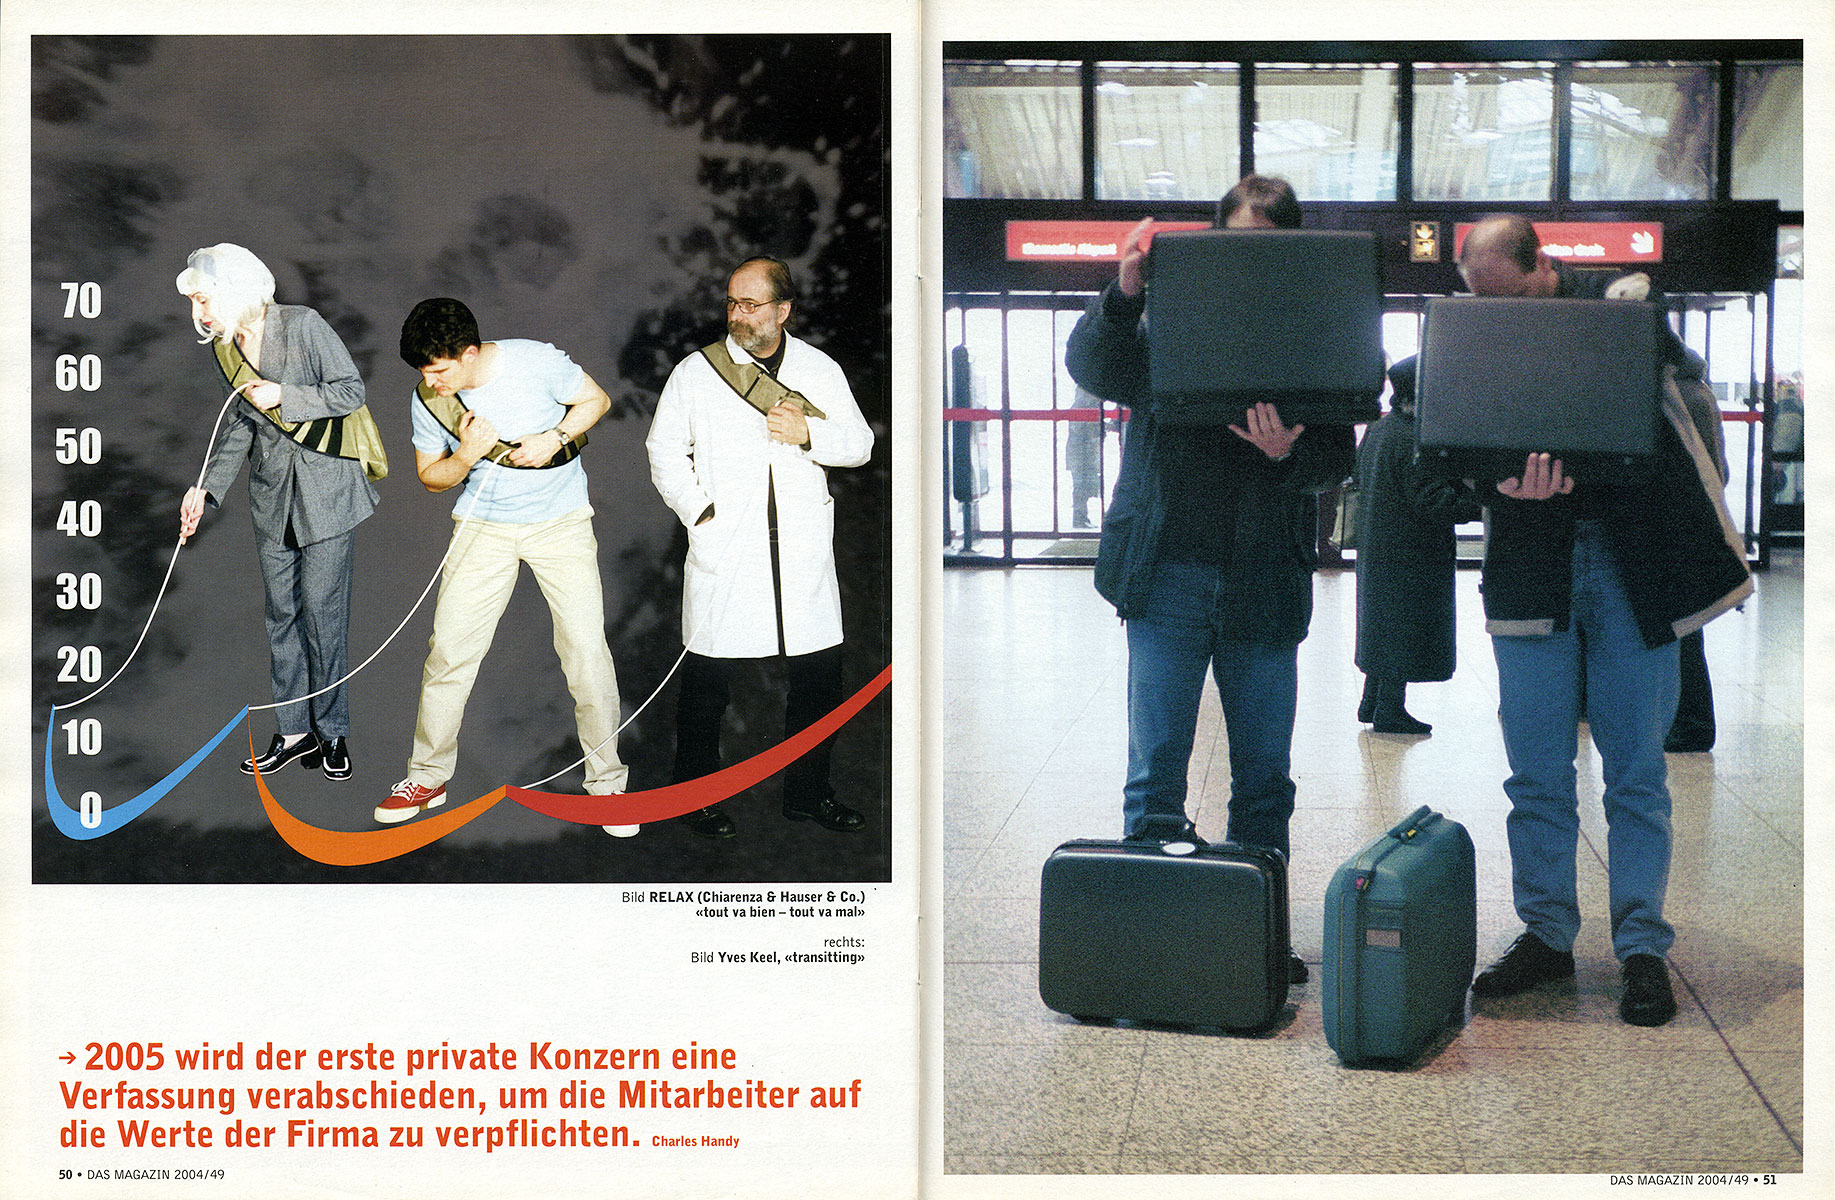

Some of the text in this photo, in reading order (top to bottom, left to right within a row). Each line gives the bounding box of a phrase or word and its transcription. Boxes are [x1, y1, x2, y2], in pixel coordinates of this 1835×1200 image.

[60, 281, 102, 319] 70
[55, 354, 102, 392] 60
[55, 427, 102, 465] 50
[56, 500, 102, 537] 40
[56, 572, 102, 610] 30
[56, 645, 102, 683] 20
[61, 718, 102, 756] 10
[79, 791, 102, 829] 0
[622, 891, 866, 905] Bild RELAX (Chiarenza & Hauser & Co.)
[695, 906, 729, 918] «tout
[732, 908, 747, 918] va
[750, 906, 776, 918] bien
[789, 906, 815, 918] tout
[818, 908, 832, 918] va
[835, 906, 865, 918] mal»
[691, 951, 865, 965] Bild Yves Keel, «transitting»
[824, 936, 866, 948] rechts:
[84, 1040, 737, 1077] 2005 wird der erste private Konzern eine
[58, 1078, 862, 1115] Verfassung verabschieden, um die Mitarbeiter auf
[60, 1118, 640, 1154] die Werte der Firma zu verpflichten.
[652, 1135, 740, 1149] Charles Handy
[58, 1169, 225, 1181] 50 DAS MAGAZIN 2004/49
[1610, 1175, 1777, 1186] DAS MAGAZIN 2004/49 51
